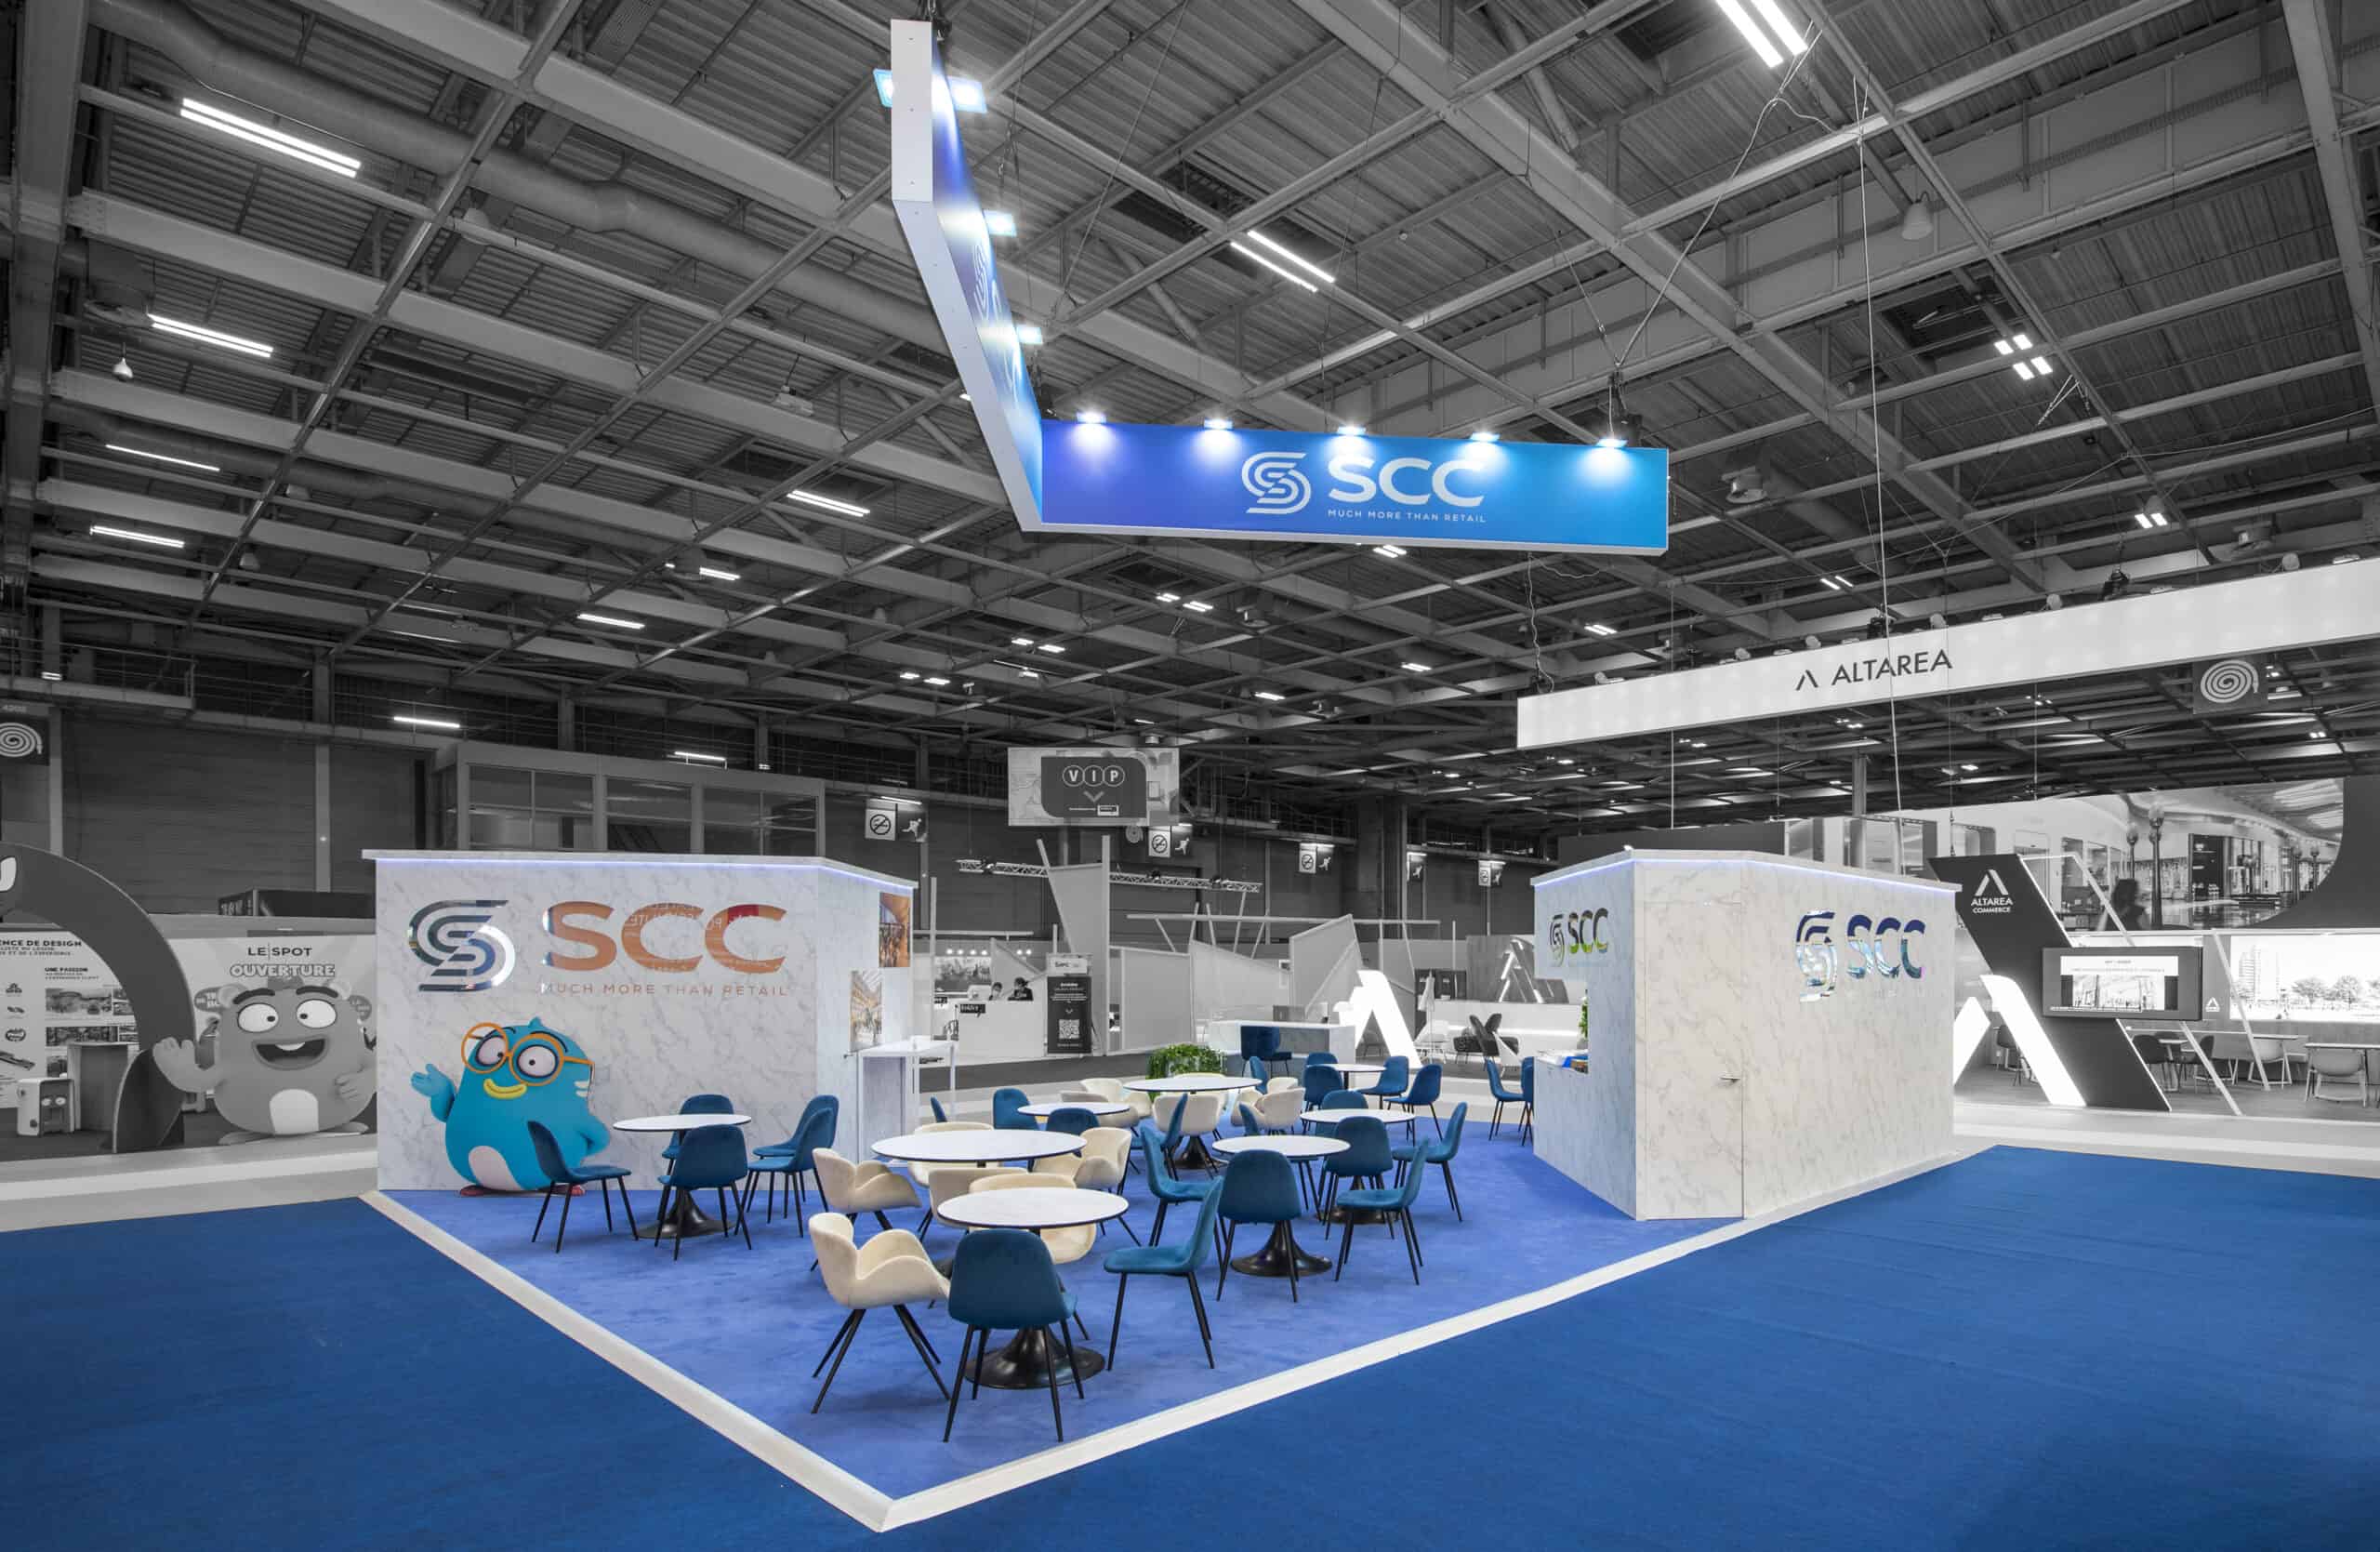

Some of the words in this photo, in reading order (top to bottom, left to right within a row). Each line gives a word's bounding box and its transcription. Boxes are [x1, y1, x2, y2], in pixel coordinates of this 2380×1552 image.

[1328, 456, 1485, 508] SCC
[1328, 509, 1362, 519] MUCH
[1368, 511, 1401, 521] MORE
[1406, 512, 1438, 522] THAN
[1444, 513, 1487, 524] RETAIL
[1831, 648, 1953, 686] ALTAREA
[1068, 770, 1119, 782] VIP
[1970, 897, 2014, 907] ALTAREA
[543, 901, 787, 975] SCC
[1567, 907, 1608, 954] SCC
[247, 947, 267, 956] LE
[271, 947, 312, 957] SPOT
[1845, 914, 1926, 979] SCC
[229, 963, 336, 977] OUVERTURE
[540, 983, 594, 995] MUCH
[604, 984, 655, 995] MORE
[661, 984, 713, 996] THAN
[722, 985, 788, 997] RETAIL
